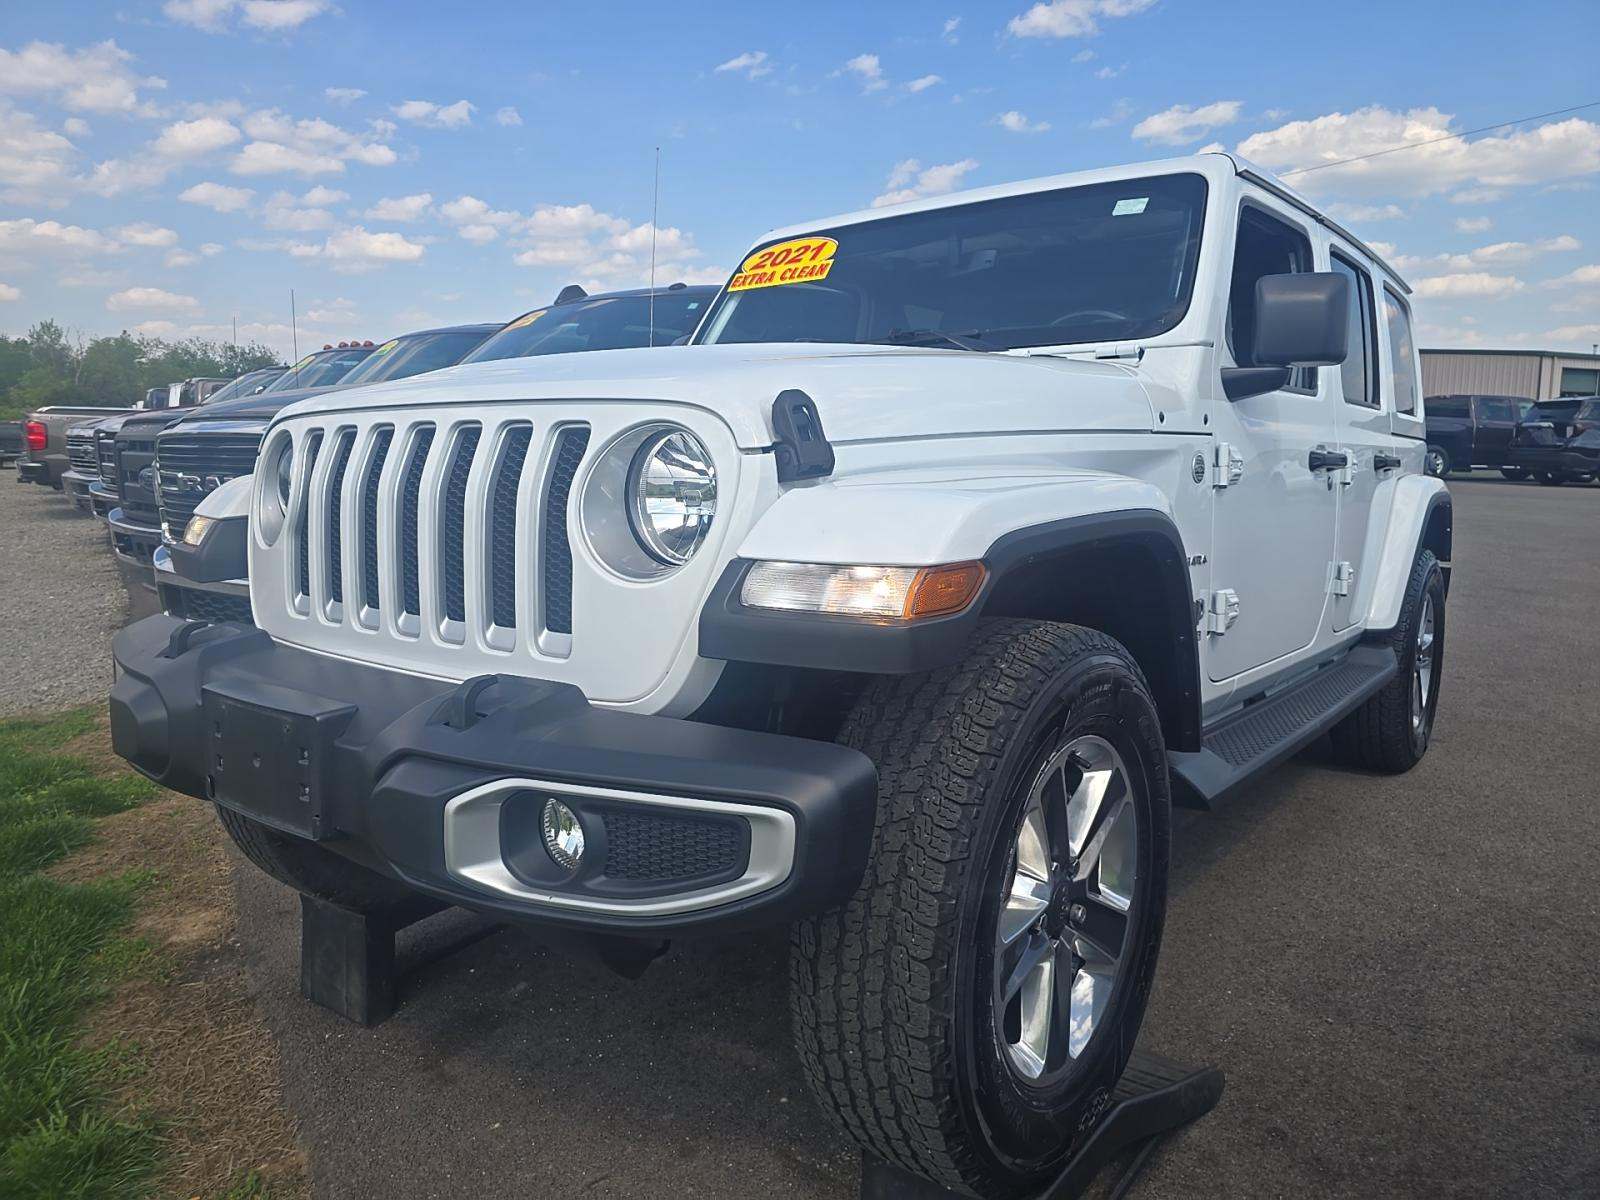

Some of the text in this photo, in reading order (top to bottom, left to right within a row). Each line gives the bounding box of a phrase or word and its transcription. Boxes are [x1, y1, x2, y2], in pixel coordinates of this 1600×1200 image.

[748, 240, 828, 271] 2021
[731, 263, 831, 288] EXTRA CLEAN
[179, 474, 233, 491] RA
